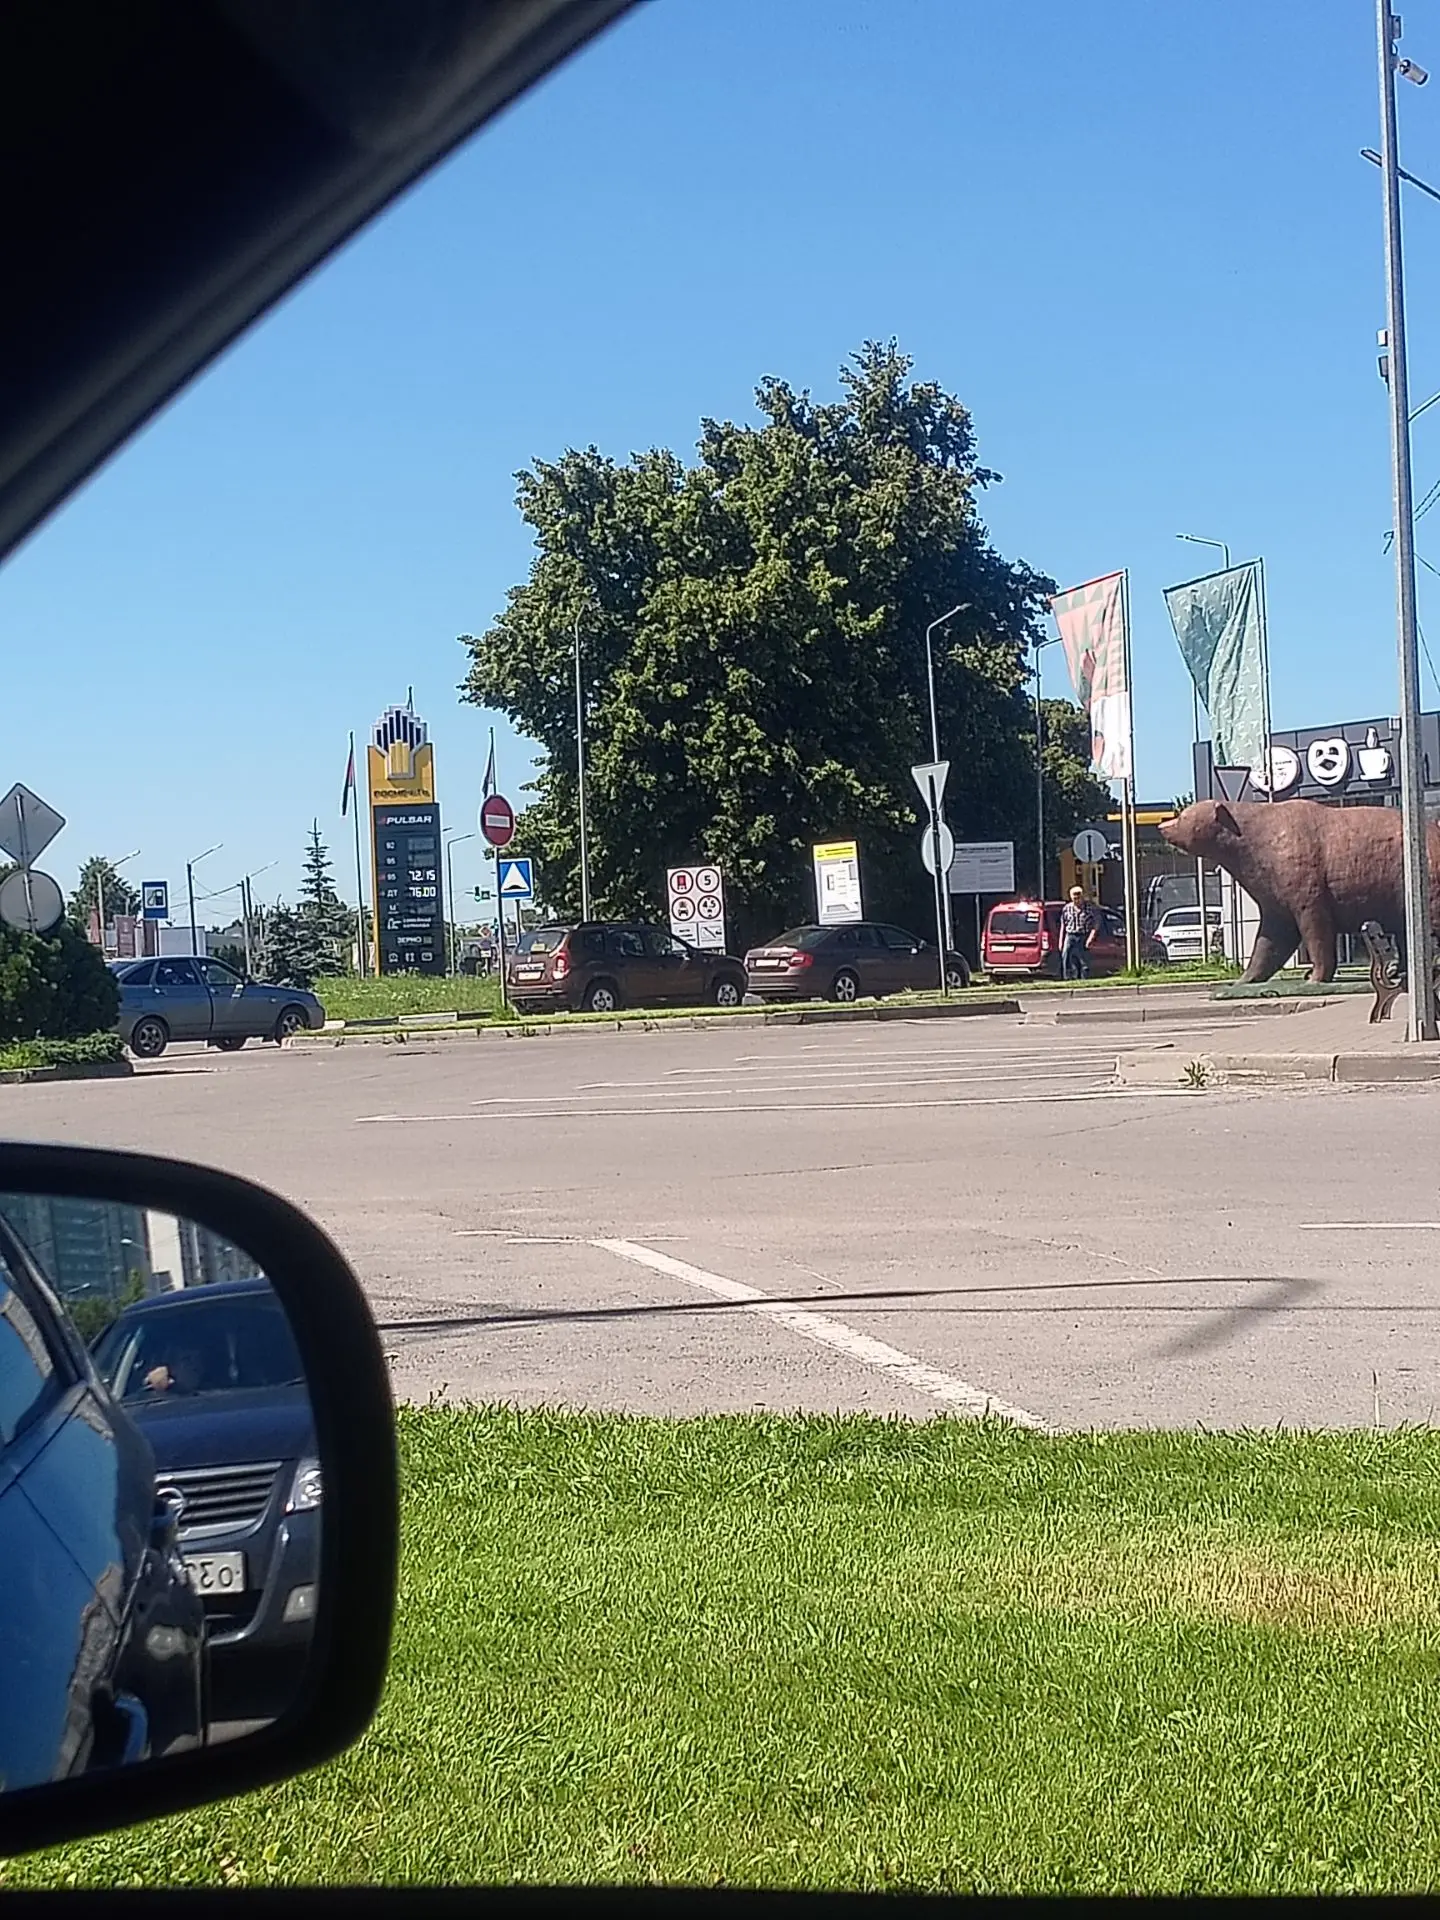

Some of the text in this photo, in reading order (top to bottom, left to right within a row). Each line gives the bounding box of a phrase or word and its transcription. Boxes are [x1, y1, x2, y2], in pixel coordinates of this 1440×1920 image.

[385, 815, 433, 825] PULSAR
[704, 875, 712, 886] 5
[387, 886, 437, 898] ДТ 76.00
